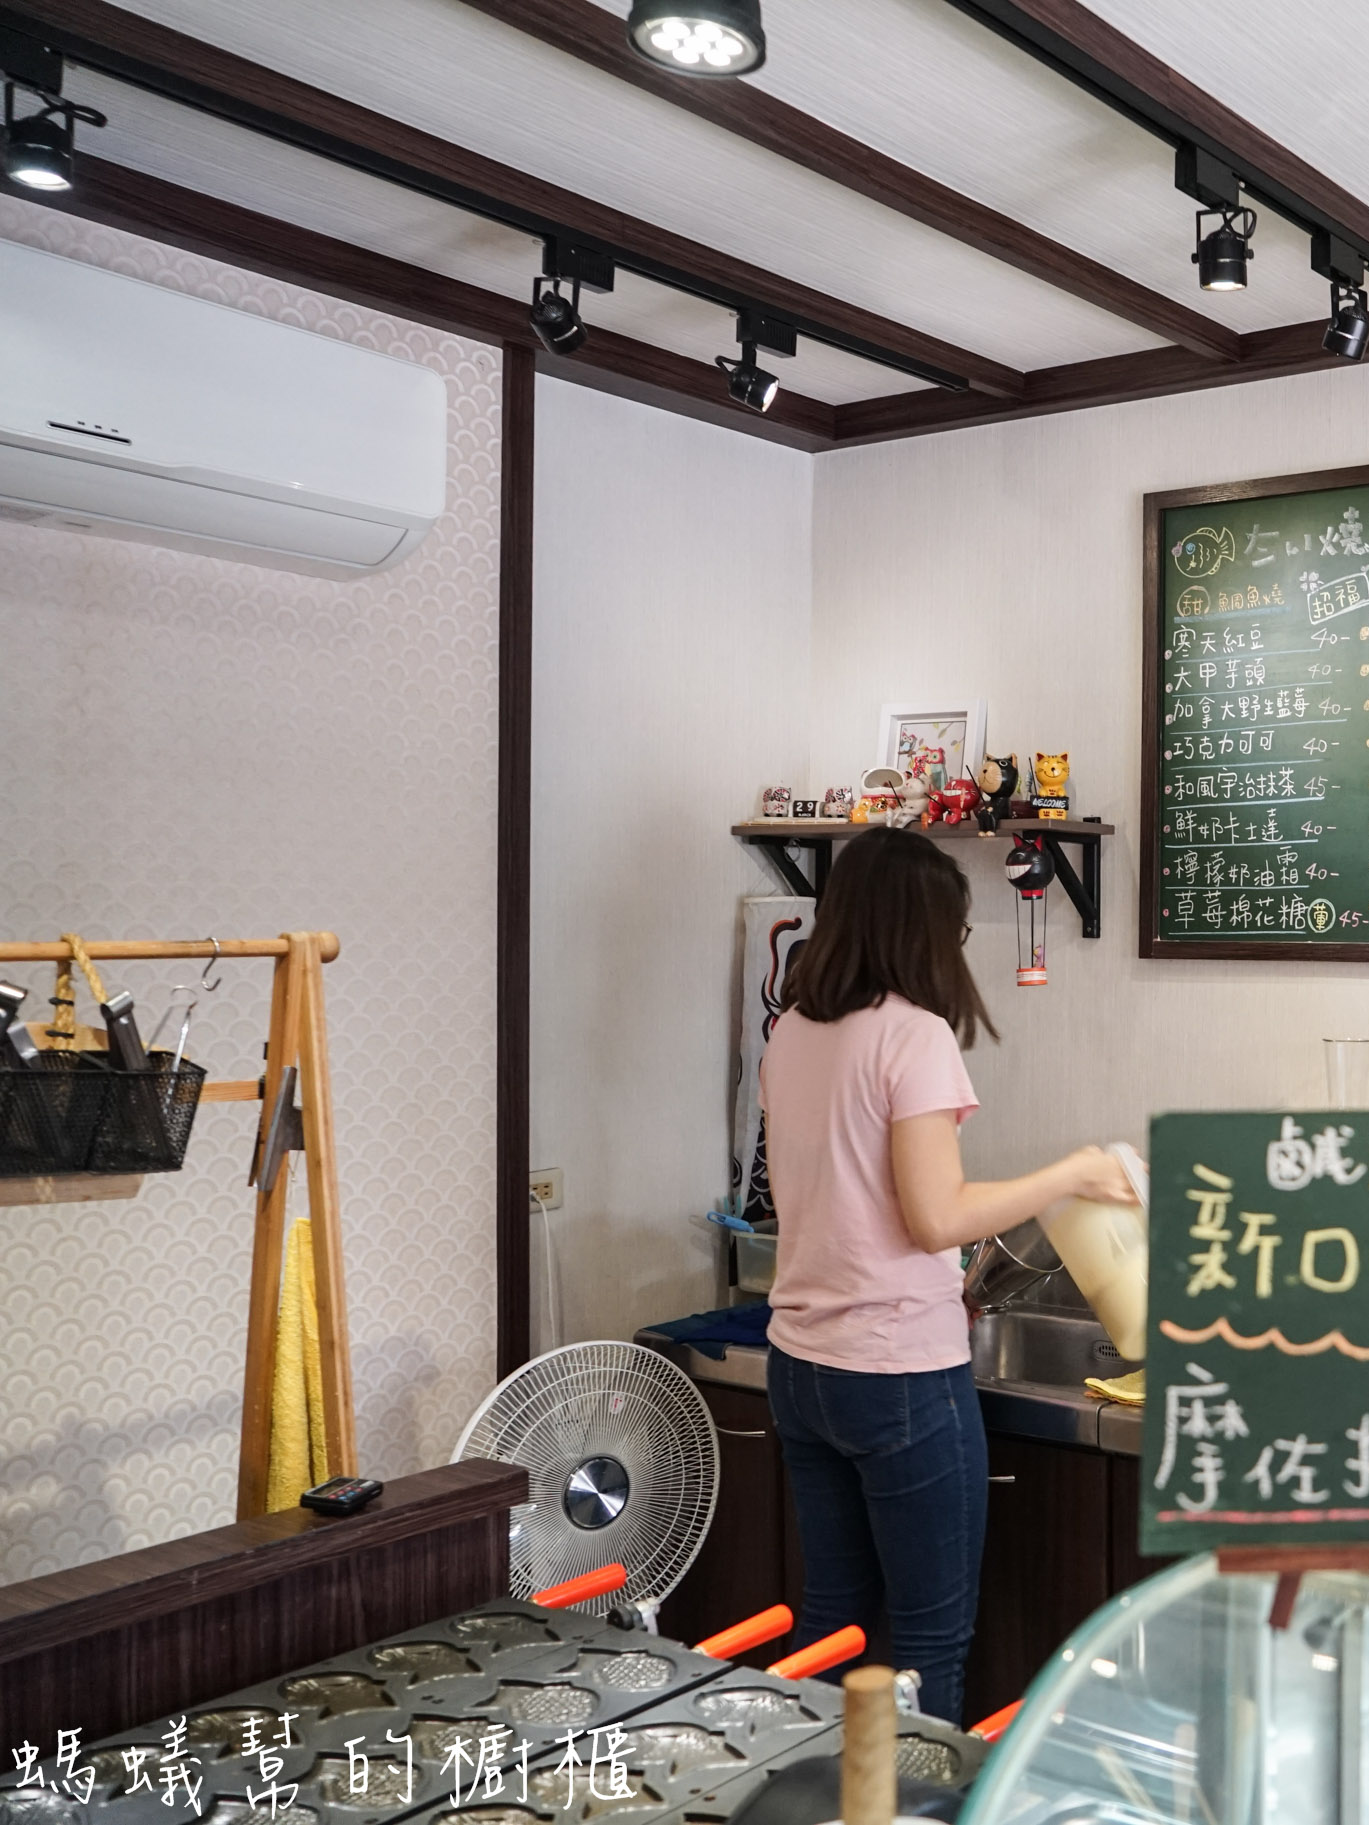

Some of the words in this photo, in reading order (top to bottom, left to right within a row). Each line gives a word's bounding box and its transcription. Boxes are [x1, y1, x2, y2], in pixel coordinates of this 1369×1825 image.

[1183, 595, 1204, 616] 甜
[1312, 580, 1361, 619] 招福
[1173, 624, 1264, 658] 寒天紅豆
[1174, 658, 1266, 691] 大甲芋頭
[1173, 730, 1274, 760] 巧克力可可
[1174, 766, 1297, 800] 和風宇治抹茶
[1032, 798, 1067, 808] WELCOME
